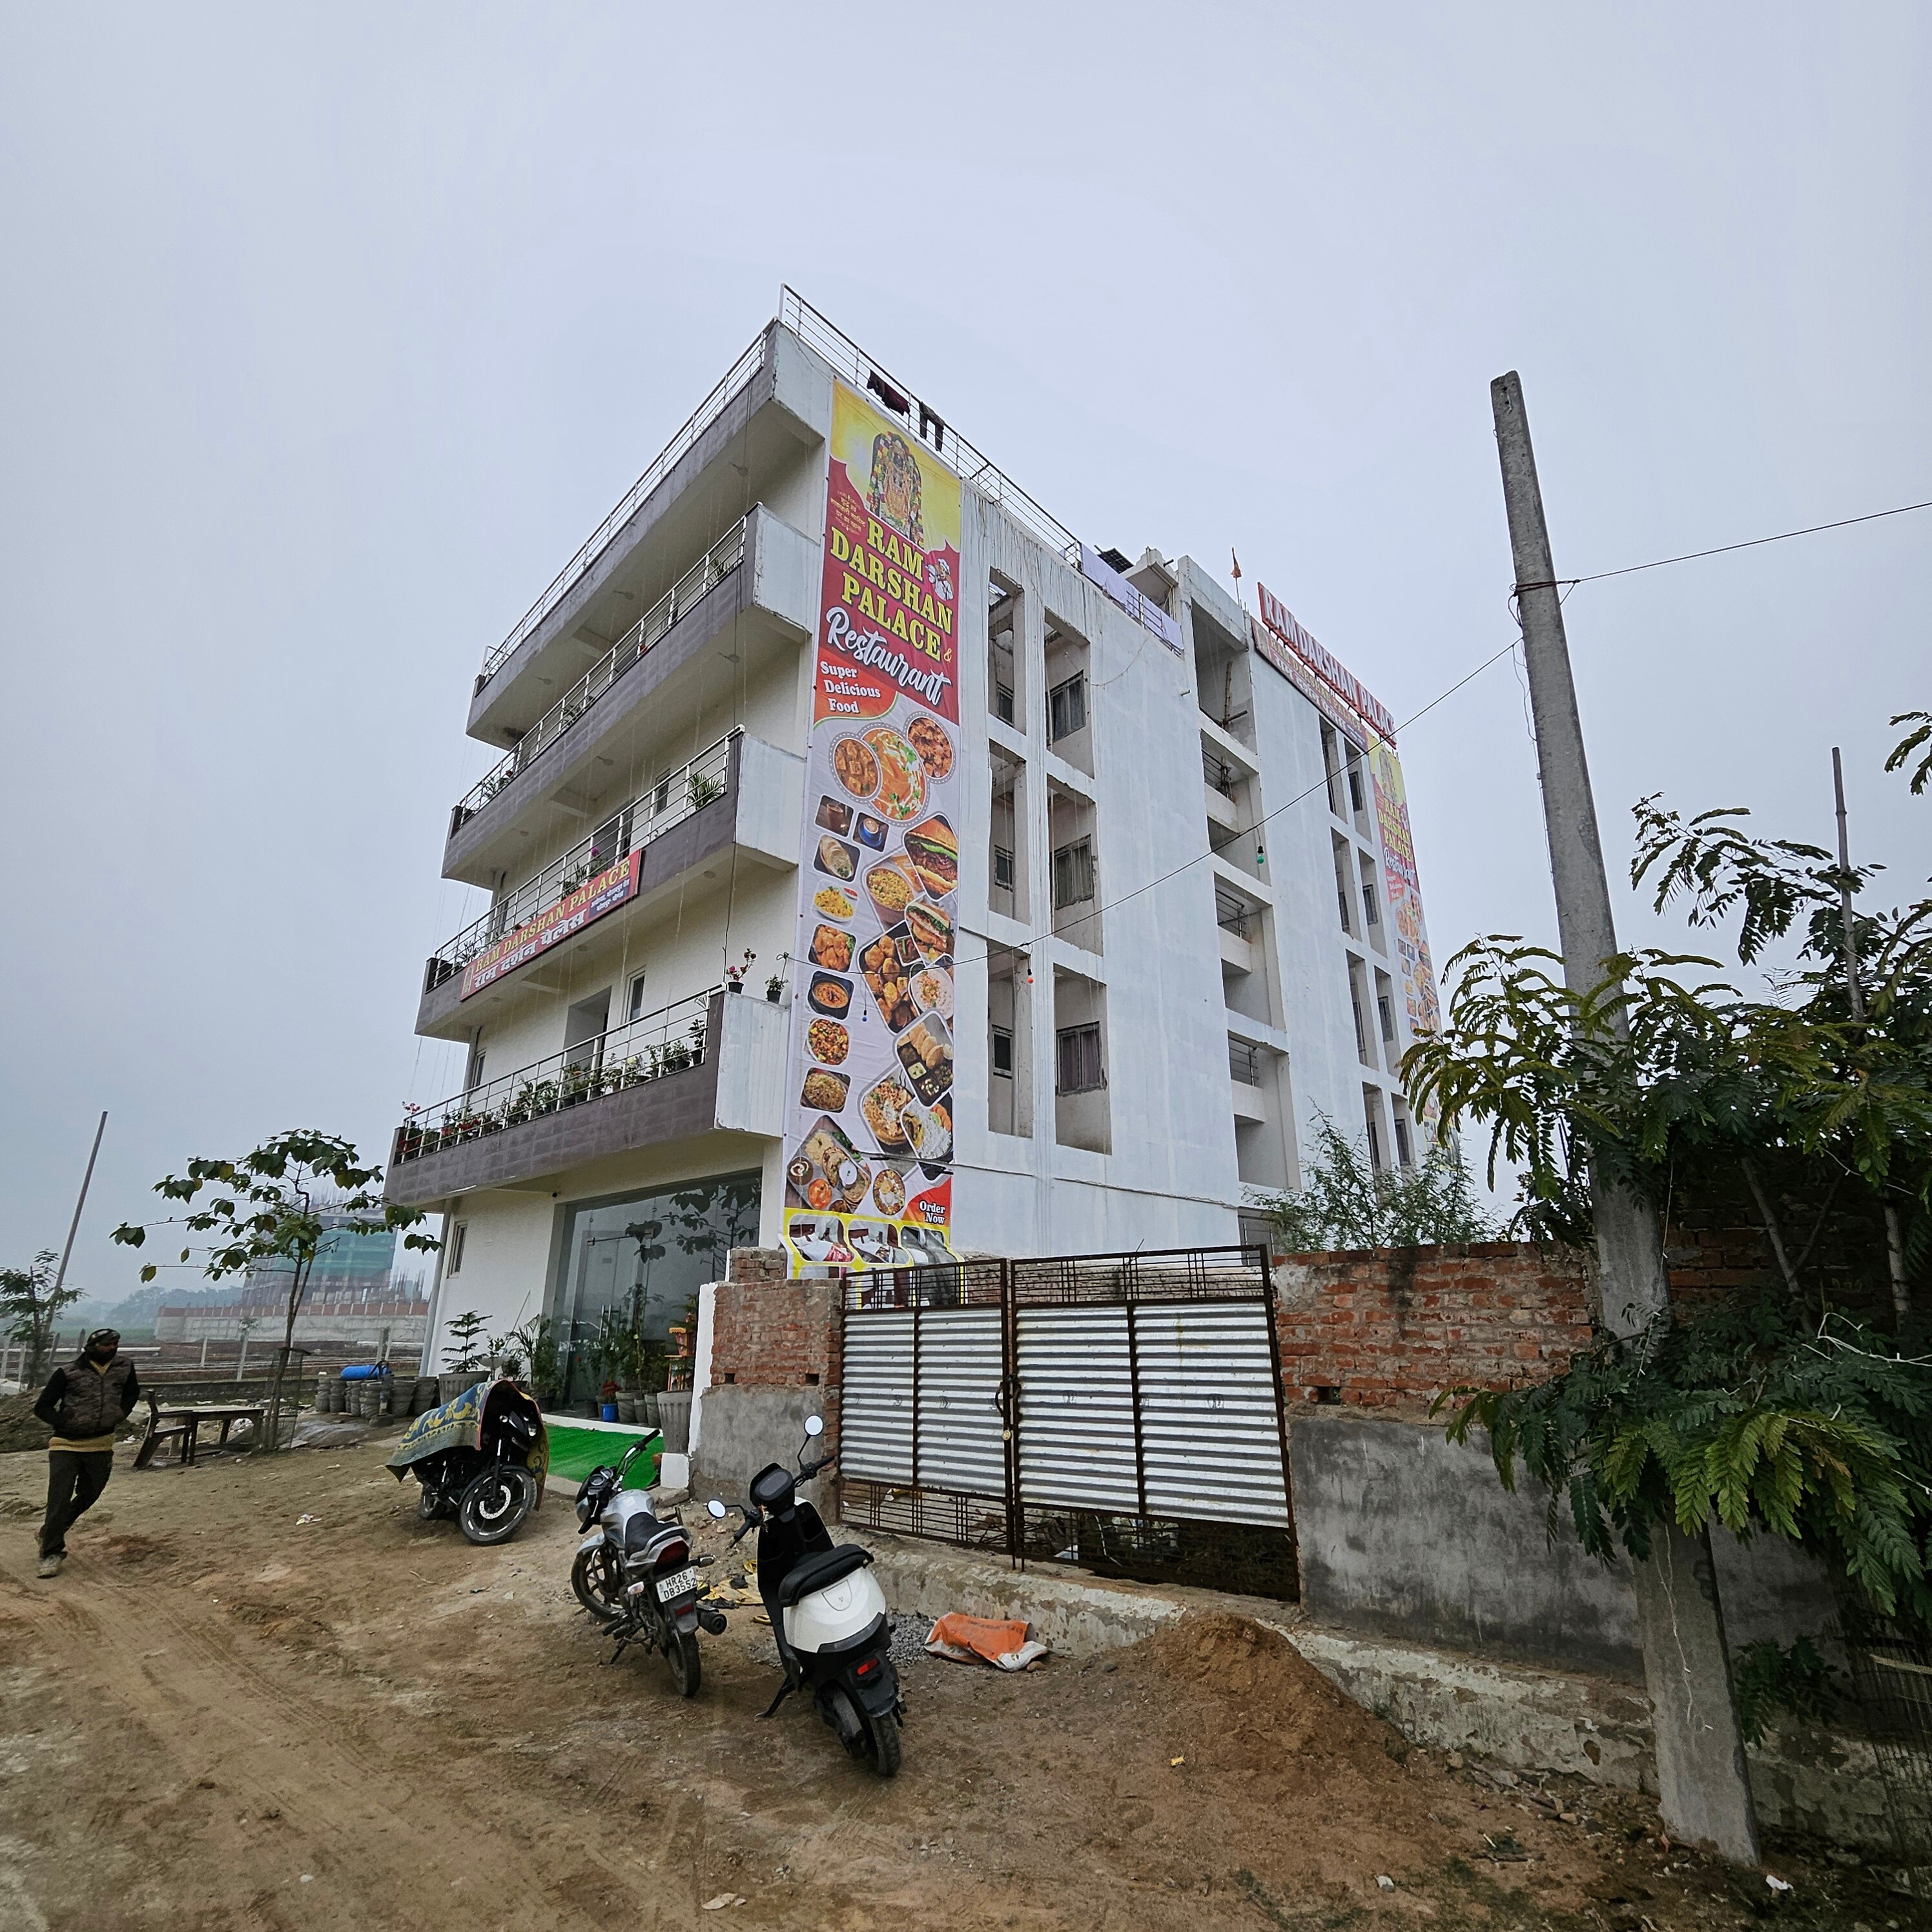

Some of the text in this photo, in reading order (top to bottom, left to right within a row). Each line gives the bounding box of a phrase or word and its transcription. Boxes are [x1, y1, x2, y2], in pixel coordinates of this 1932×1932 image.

[867, 517, 924, 581] RAM
[830, 526, 952, 635] DARSHAN
[841, 572, 952, 663] PALACE &
[826, 607, 952, 706] Restaurant
[1263, 588, 1297, 648] RAM
[1298, 621, 1356, 706] DARSHAN
[820, 661, 858, 679] Super
[824, 679, 881, 698] Delicious
[828, 698, 860, 714] Food
[1384, 828, 1412, 863] PALACE
[475, 946, 501, 972] RAM
[503, 903, 566, 955] DARSHAN
[568, 860, 630, 912] PALACE
[474, 965, 498, 988] राम
[500, 940, 538, 971] दर्शन
[919, 1200, 945, 1214] Order
[925, 1212, 945, 1225] Now
[664, 1577, 697, 1599] DB3552
[666, 1572, 688, 1588] HR26
